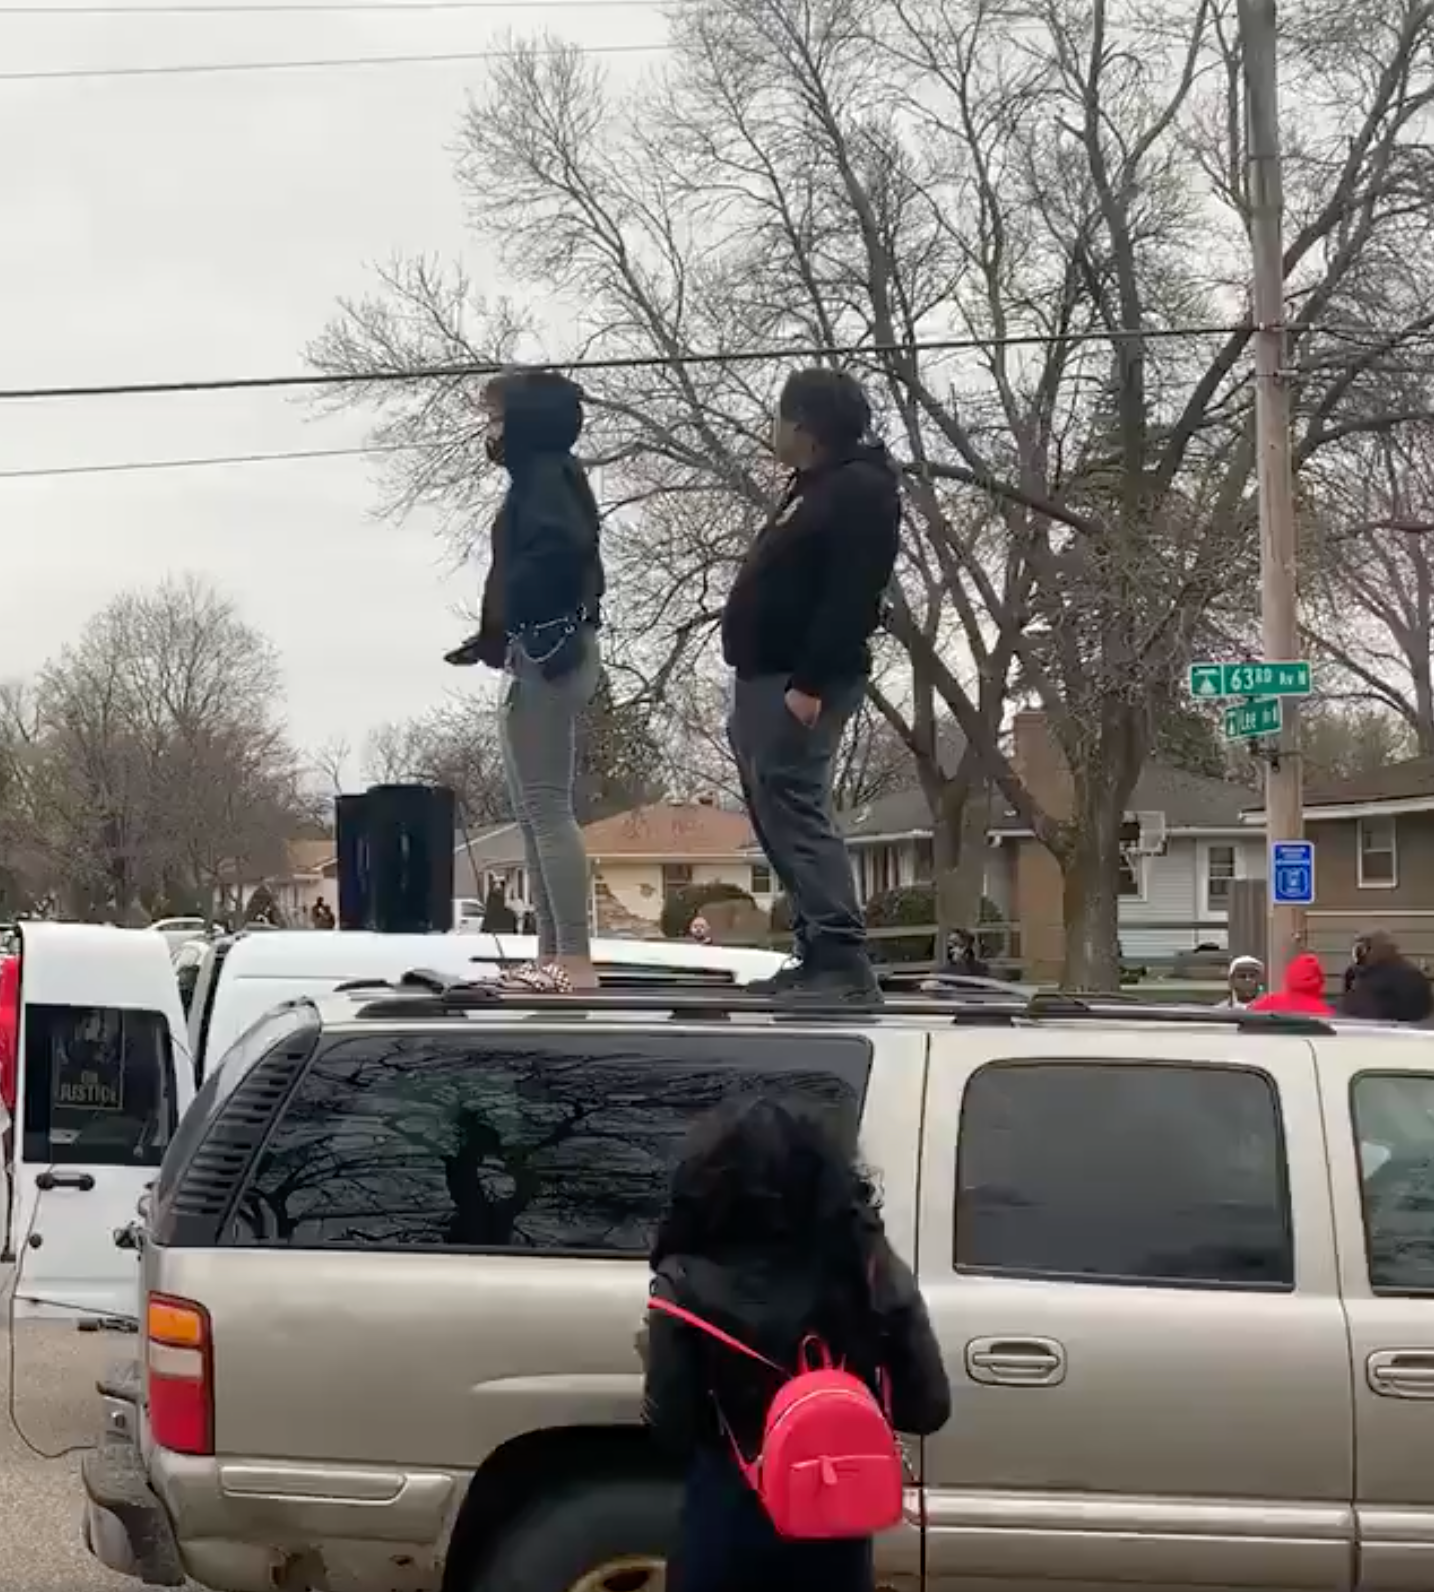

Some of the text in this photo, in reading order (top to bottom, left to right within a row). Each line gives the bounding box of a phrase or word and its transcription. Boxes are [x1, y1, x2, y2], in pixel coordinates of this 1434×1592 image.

[1230, 667, 1272, 691] 63RD
[1297, 669, 1306, 685] N
[61, 1083, 116, 1102] JUSTICE
